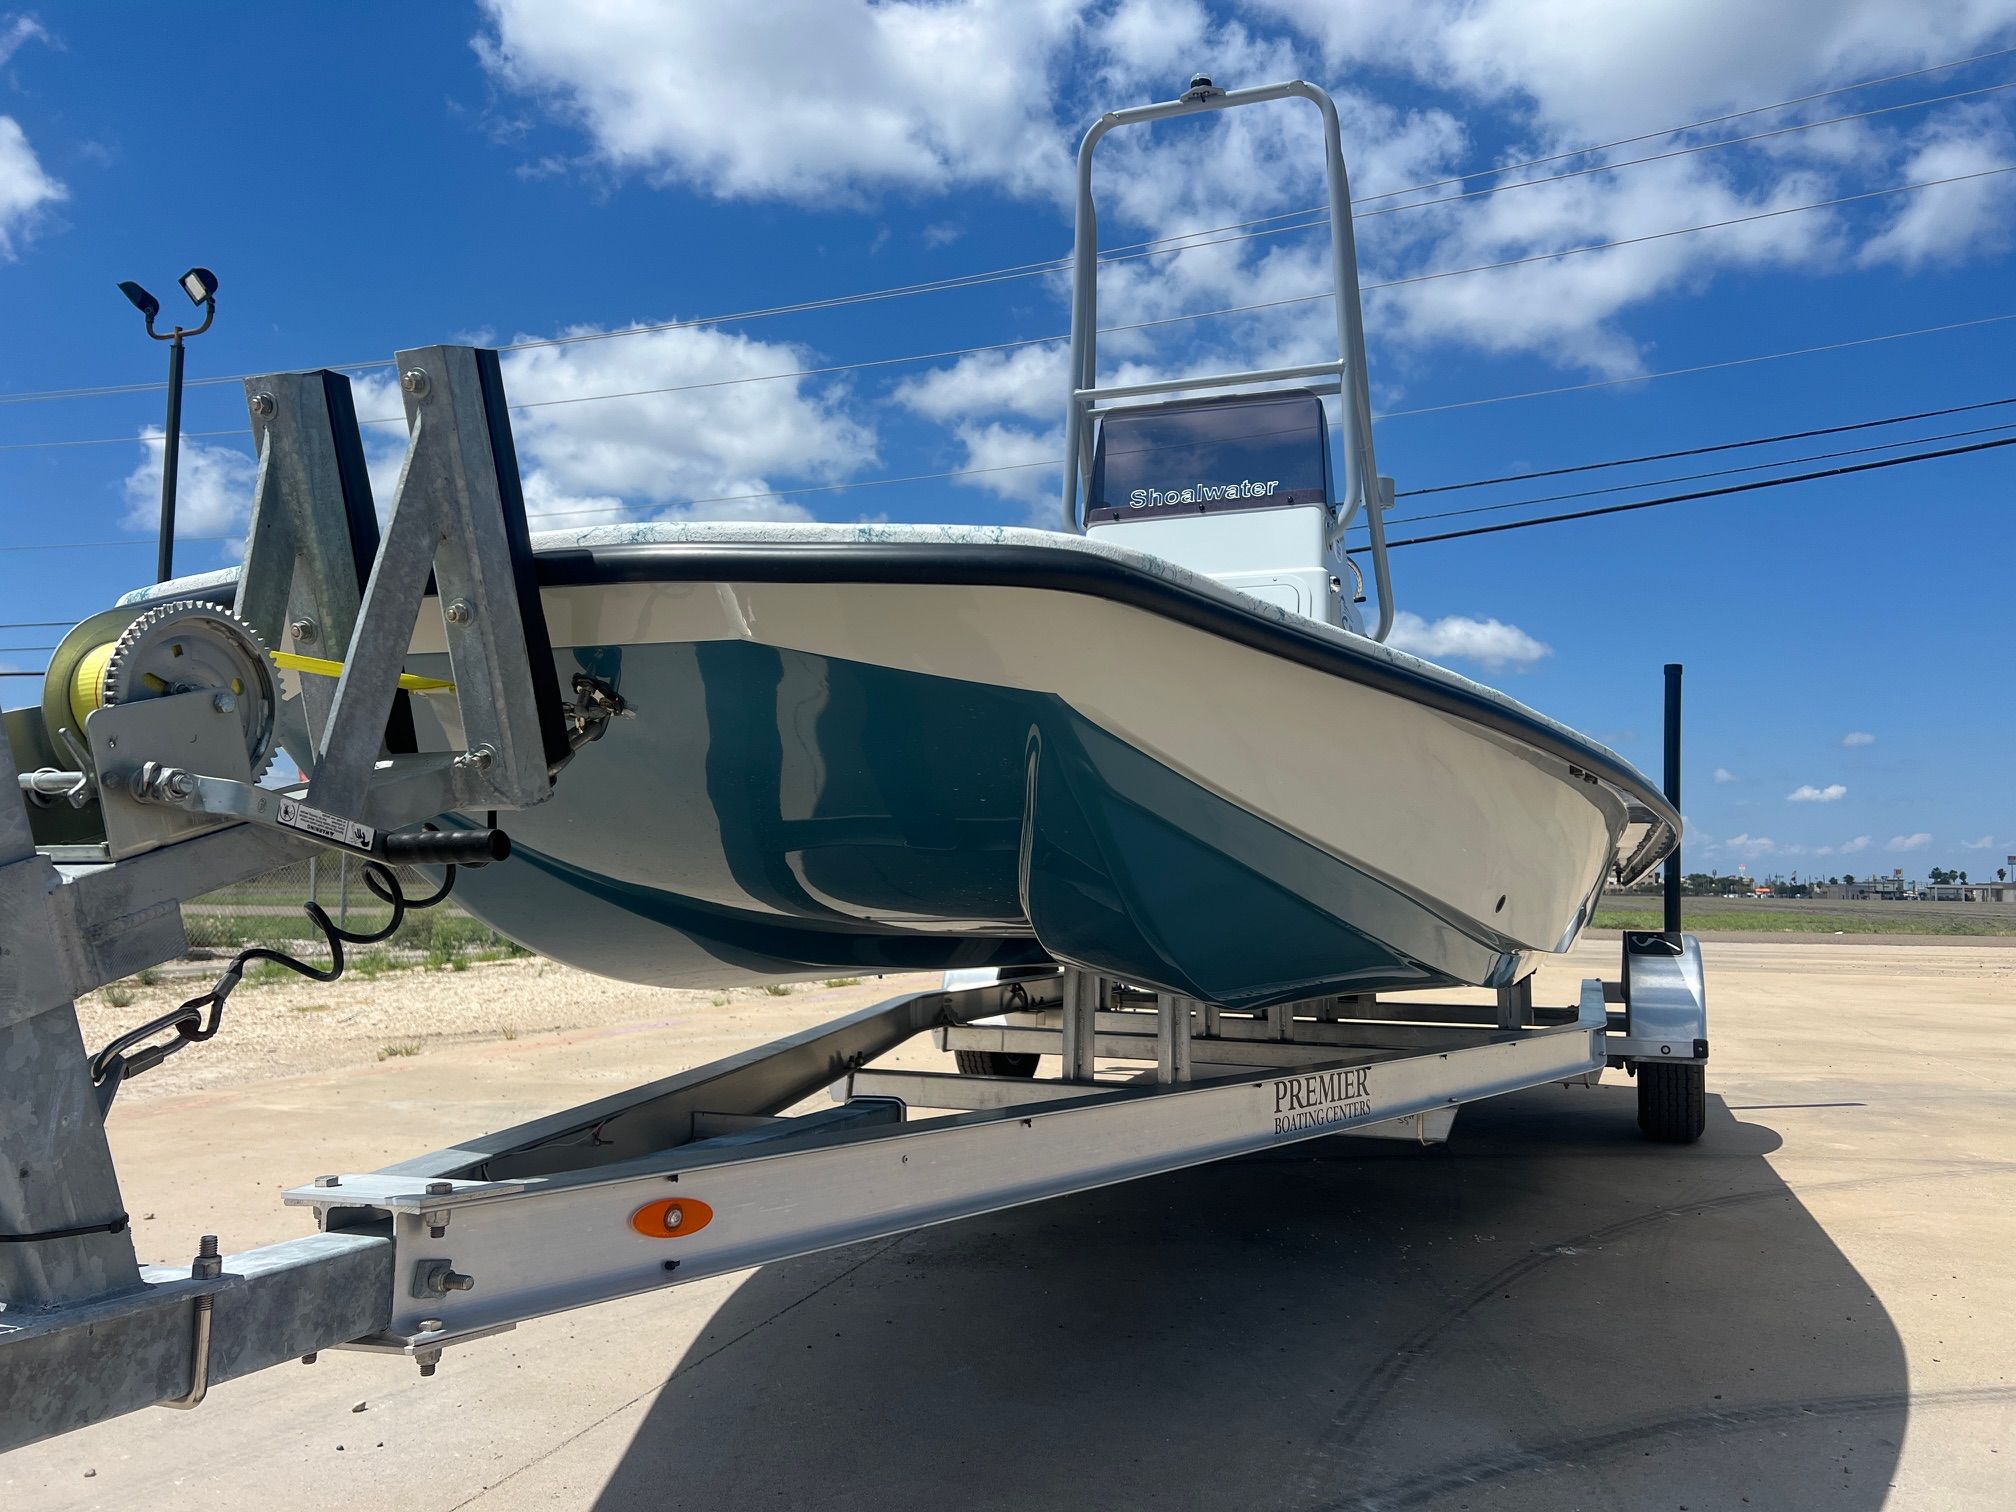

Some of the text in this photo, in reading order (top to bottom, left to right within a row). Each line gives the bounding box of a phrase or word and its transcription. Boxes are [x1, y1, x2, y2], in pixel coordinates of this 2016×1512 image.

[1130, 479, 1279, 509] Shoalwater
[307, 823, 331, 836] WARNING
[1273, 1068, 1370, 1114] PREMIER
[1274, 1108, 1325, 1135] BOATING
[1325, 1098, 1371, 1124] CENTERS
